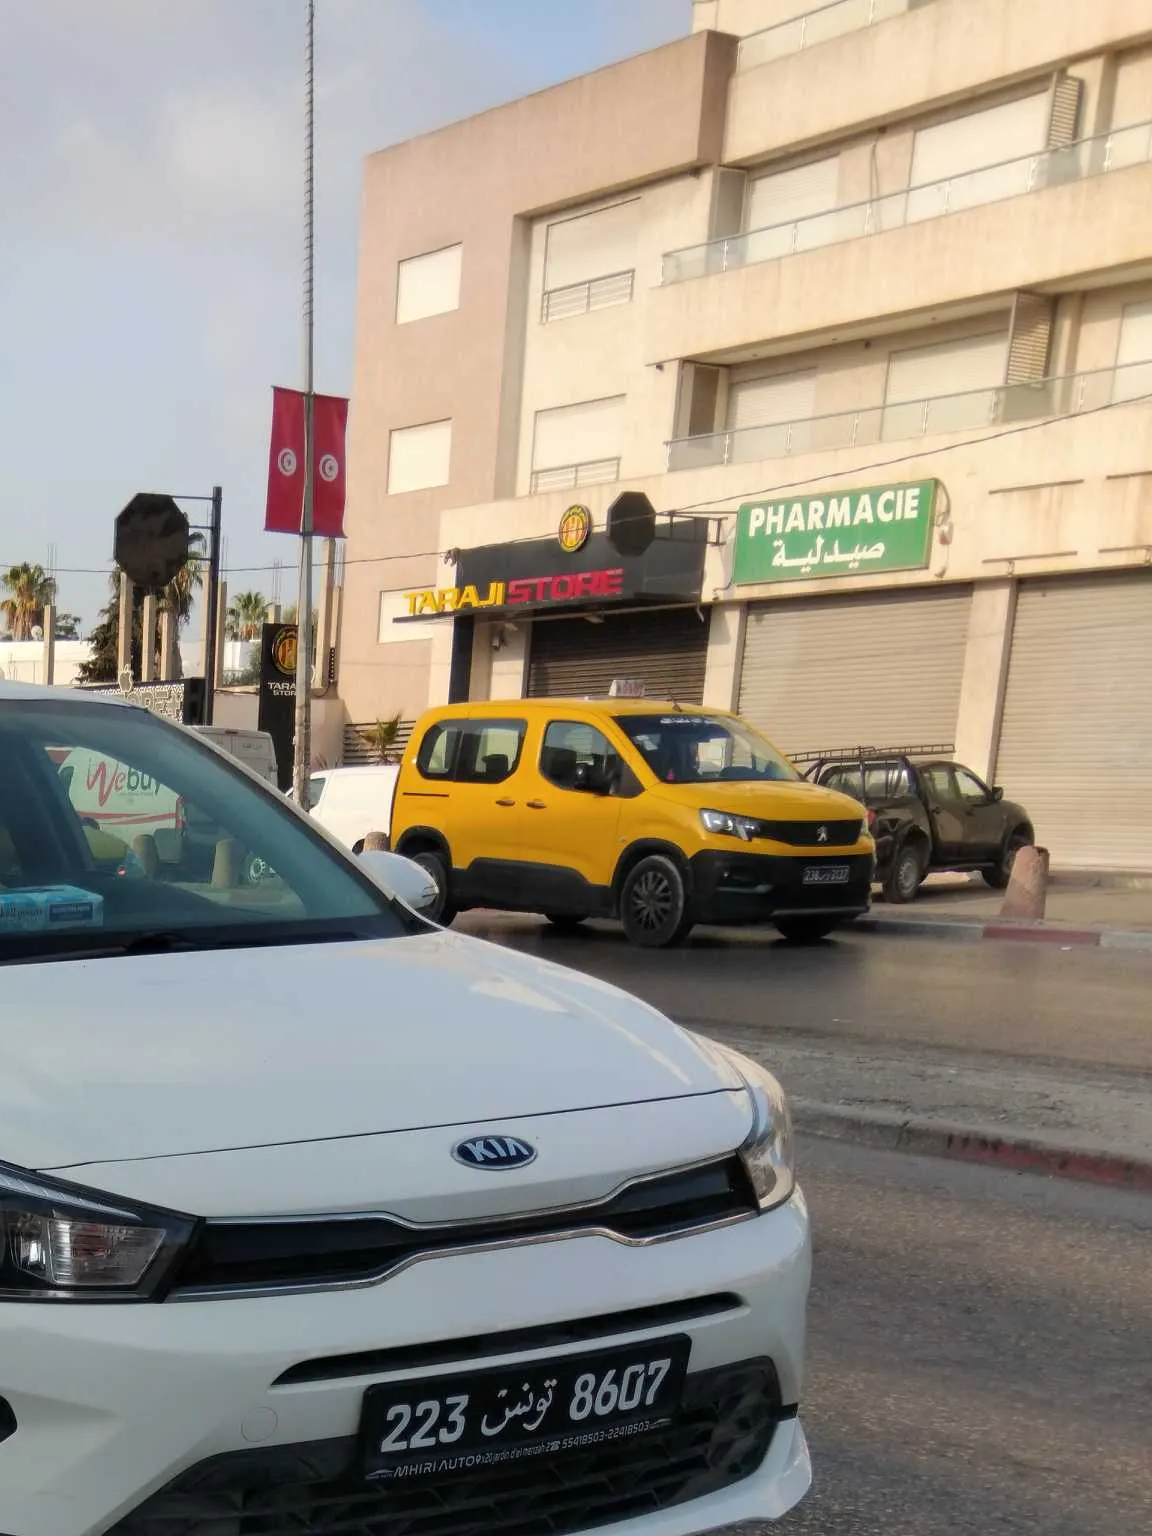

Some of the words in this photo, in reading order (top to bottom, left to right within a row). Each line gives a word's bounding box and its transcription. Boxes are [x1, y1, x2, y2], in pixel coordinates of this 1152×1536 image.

[749, 488, 920, 537] PHARMACIE
[772, 535, 885, 573] صيدلية
[403, 580, 506, 615] TARAJI
[508, 568, 624, 604] STORE
[268, 682, 297, 690] TARA
[463, 1137, 530, 1161] KIA
[381, 1394, 469, 1452] 223
[481, 1378, 558, 1436] تونس
[569, 1358, 672, 1421] 8607
[394, 1462, 436, 1478] MHIRI
[438, 1455, 475, 1471] AUTO
